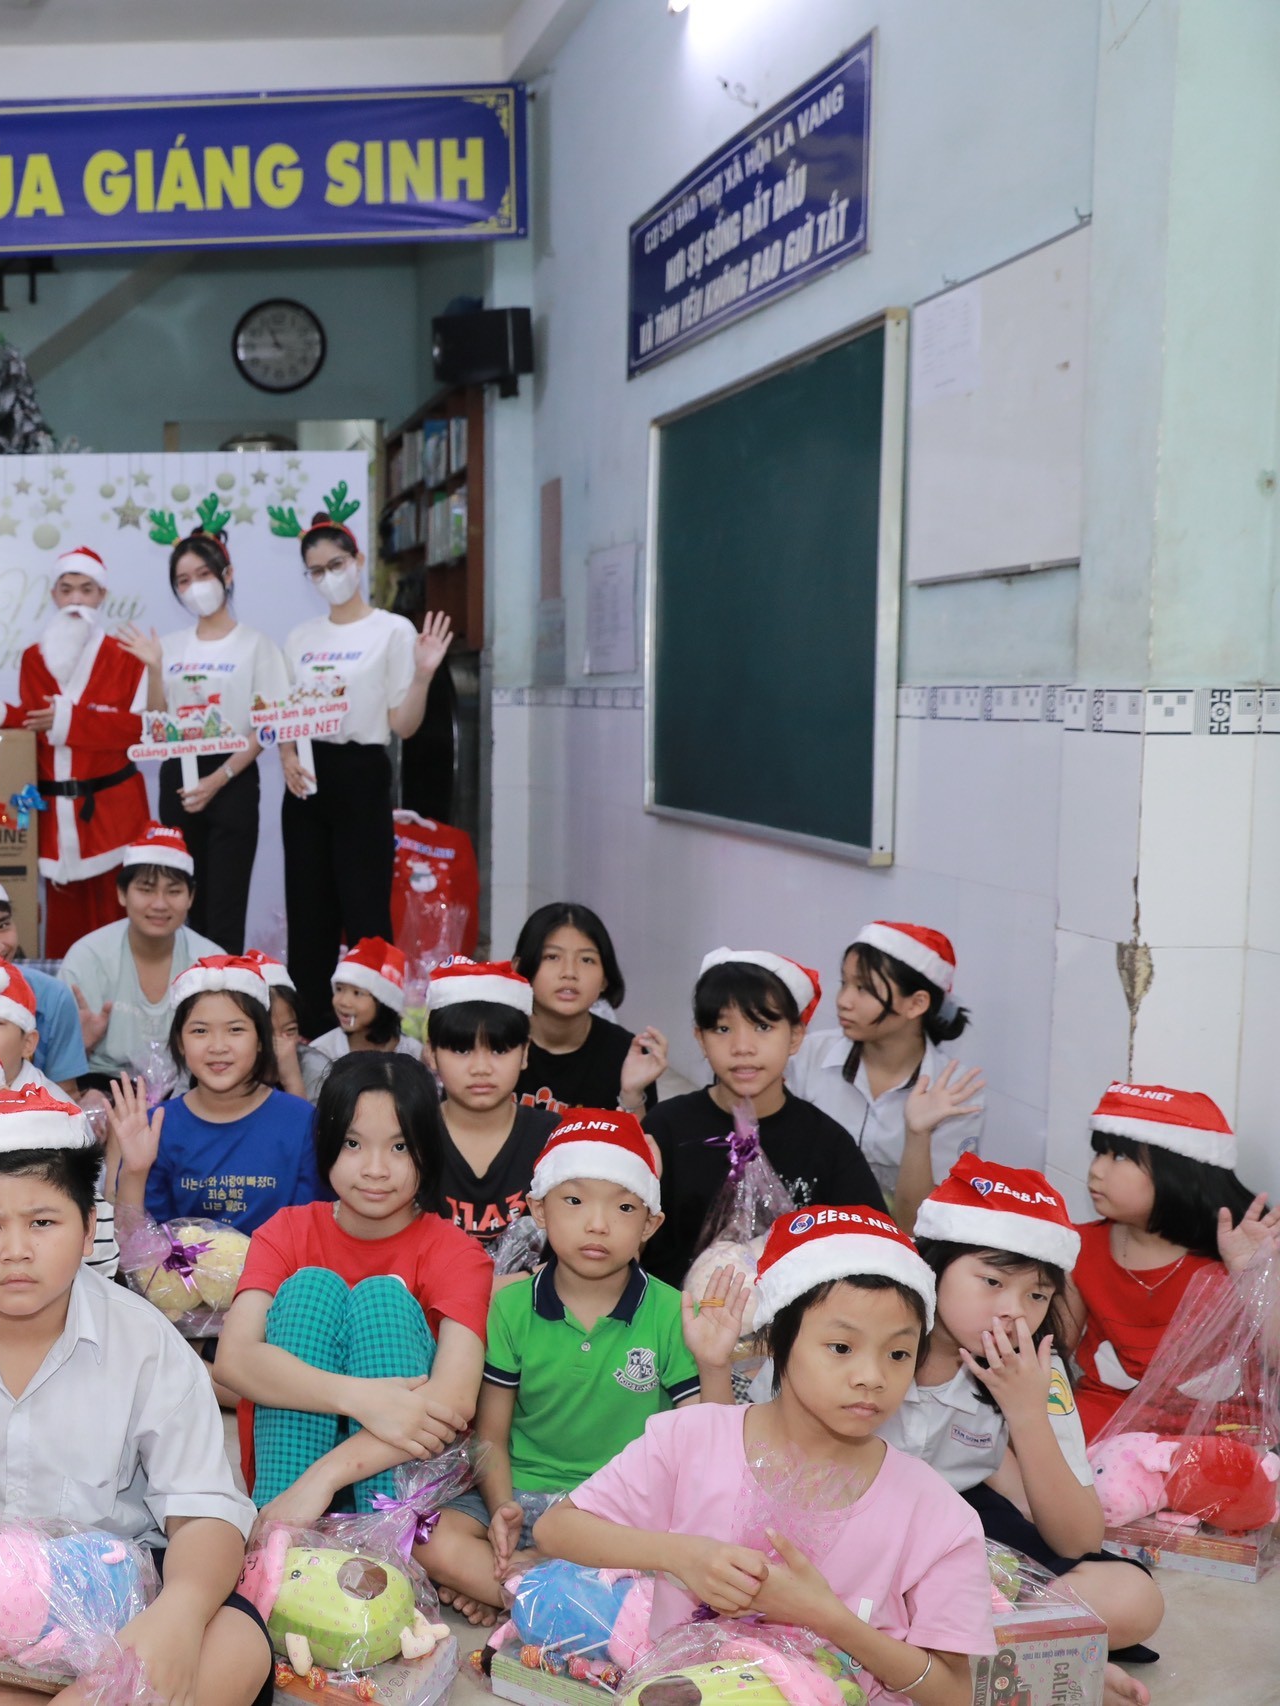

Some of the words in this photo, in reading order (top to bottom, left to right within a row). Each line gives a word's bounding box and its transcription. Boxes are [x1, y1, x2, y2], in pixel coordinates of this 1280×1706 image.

[774, 121, 795, 156] LA
[797, 83, 844, 138] VANG
[82, 134, 303, 214] GIÁNG
[324, 137, 485, 207] SINH
[749, 239, 782, 291] BAO
[171, 743, 197, 755] sinh
[201, 743, 217, 753] an
[279, 720, 340, 739] EE88.NET
[816, 1210, 899, 1236] EE88.NET
